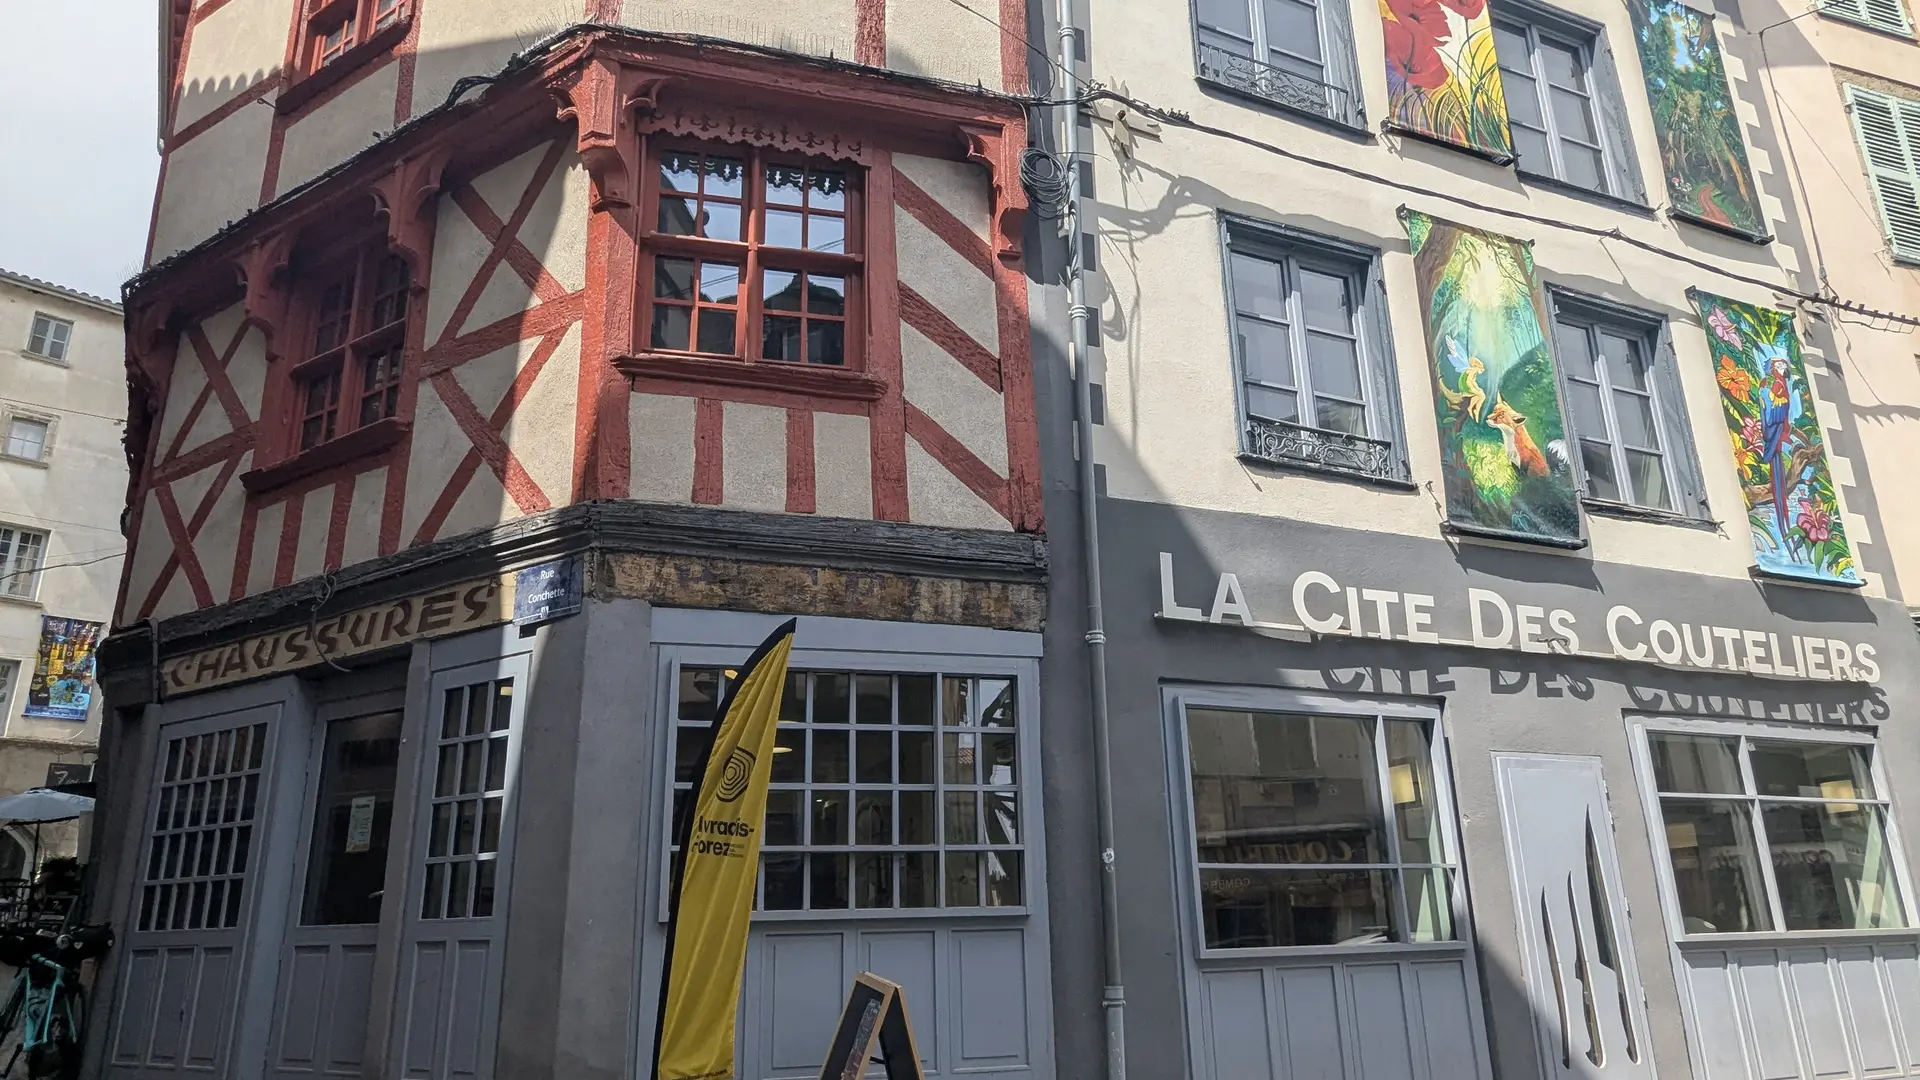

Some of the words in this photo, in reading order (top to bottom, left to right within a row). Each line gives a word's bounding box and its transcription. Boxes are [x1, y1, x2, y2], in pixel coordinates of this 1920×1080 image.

[528, 588, 565, 604] Conchette
[541, 569, 555, 580] Rue
[170, 584, 499, 688] CHAUSSURES
[1159, 551, 1254, 627] LA
[1292, 570, 1440, 644] CITE
[1468, 587, 1580, 655] DES
[1605, 604, 1881, 684] COUTELIERS
